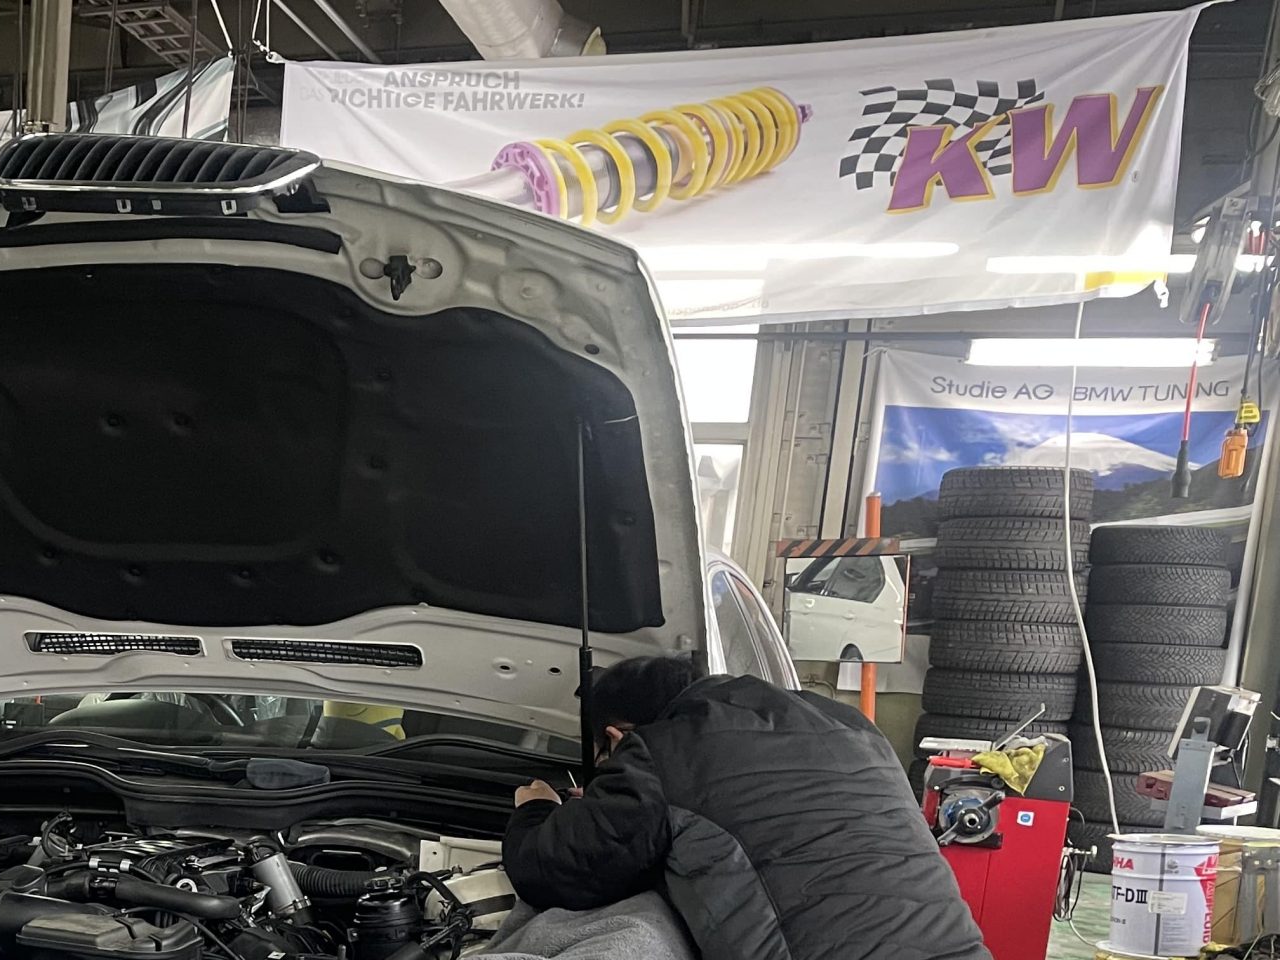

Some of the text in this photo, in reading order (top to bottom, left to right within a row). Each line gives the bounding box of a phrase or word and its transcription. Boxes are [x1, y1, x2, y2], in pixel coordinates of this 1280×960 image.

[383, 71, 520, 90] ANSPRUCH
[442, 91, 585, 112] FAHRWERK!
[886, 84, 1165, 215] KW
[930, 376, 1230, 402] Studie AG BMW TUNNG
